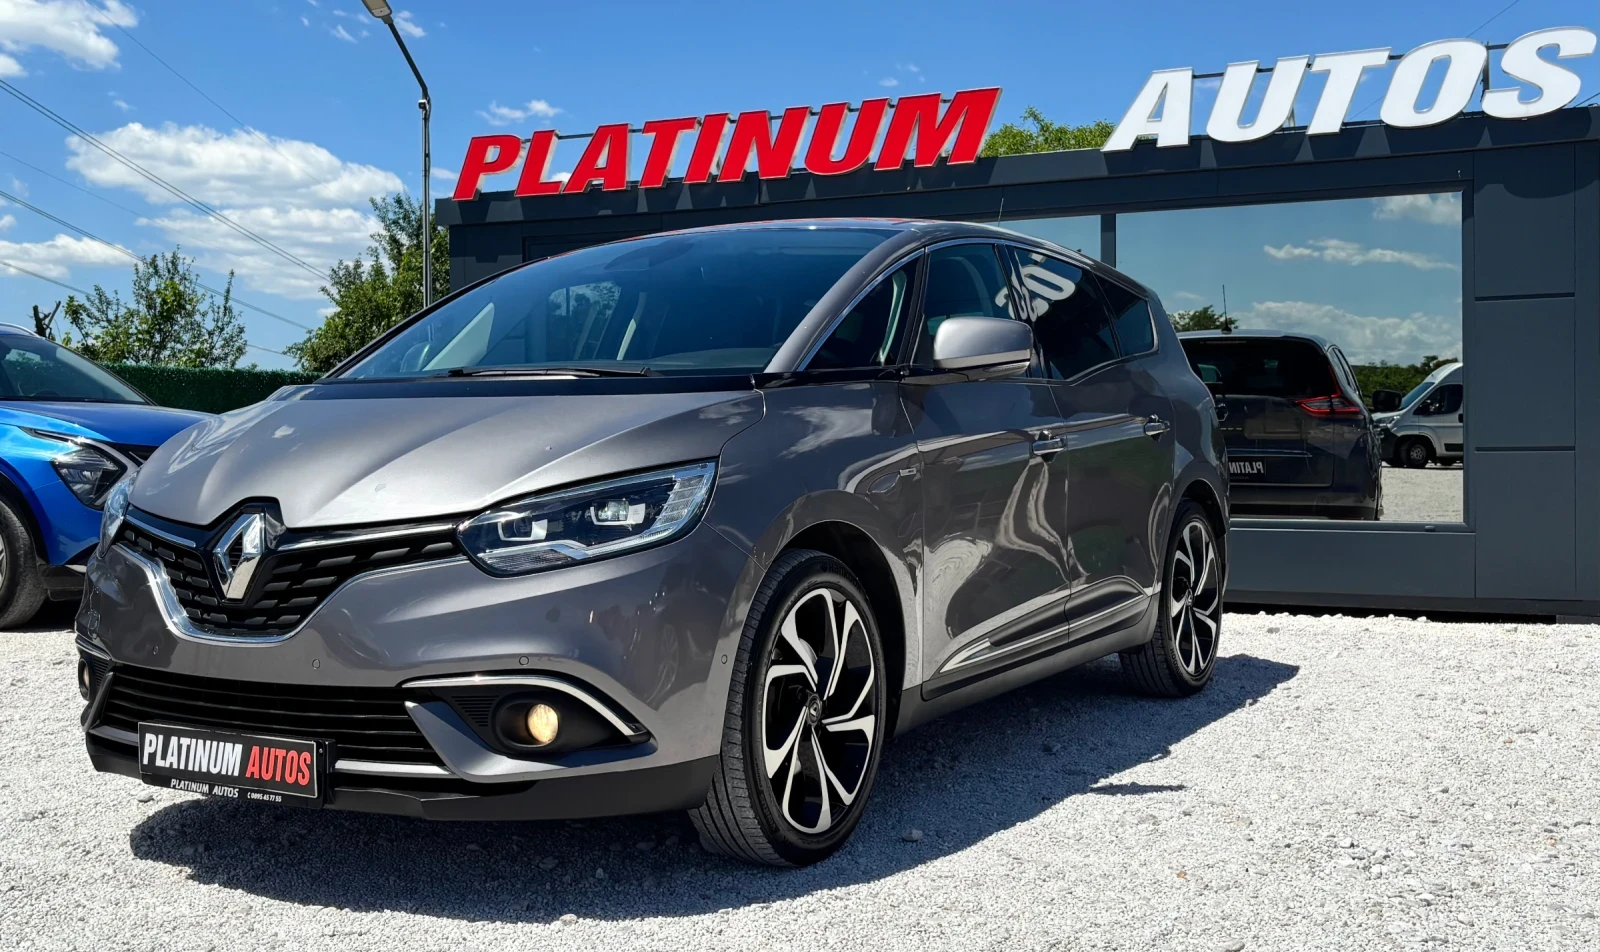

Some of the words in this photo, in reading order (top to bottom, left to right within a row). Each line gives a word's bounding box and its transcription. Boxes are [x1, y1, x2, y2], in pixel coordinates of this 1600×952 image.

[452, 86, 1003, 201] PLATINUM
[1100, 26, 1597, 153] AUTOS
[143, 733, 243, 777] PLATINUM
[245, 745, 311, 786] AUTOS
[170, 778, 209, 794] PLATINUM
[212, 785, 239, 798] AUTOS
